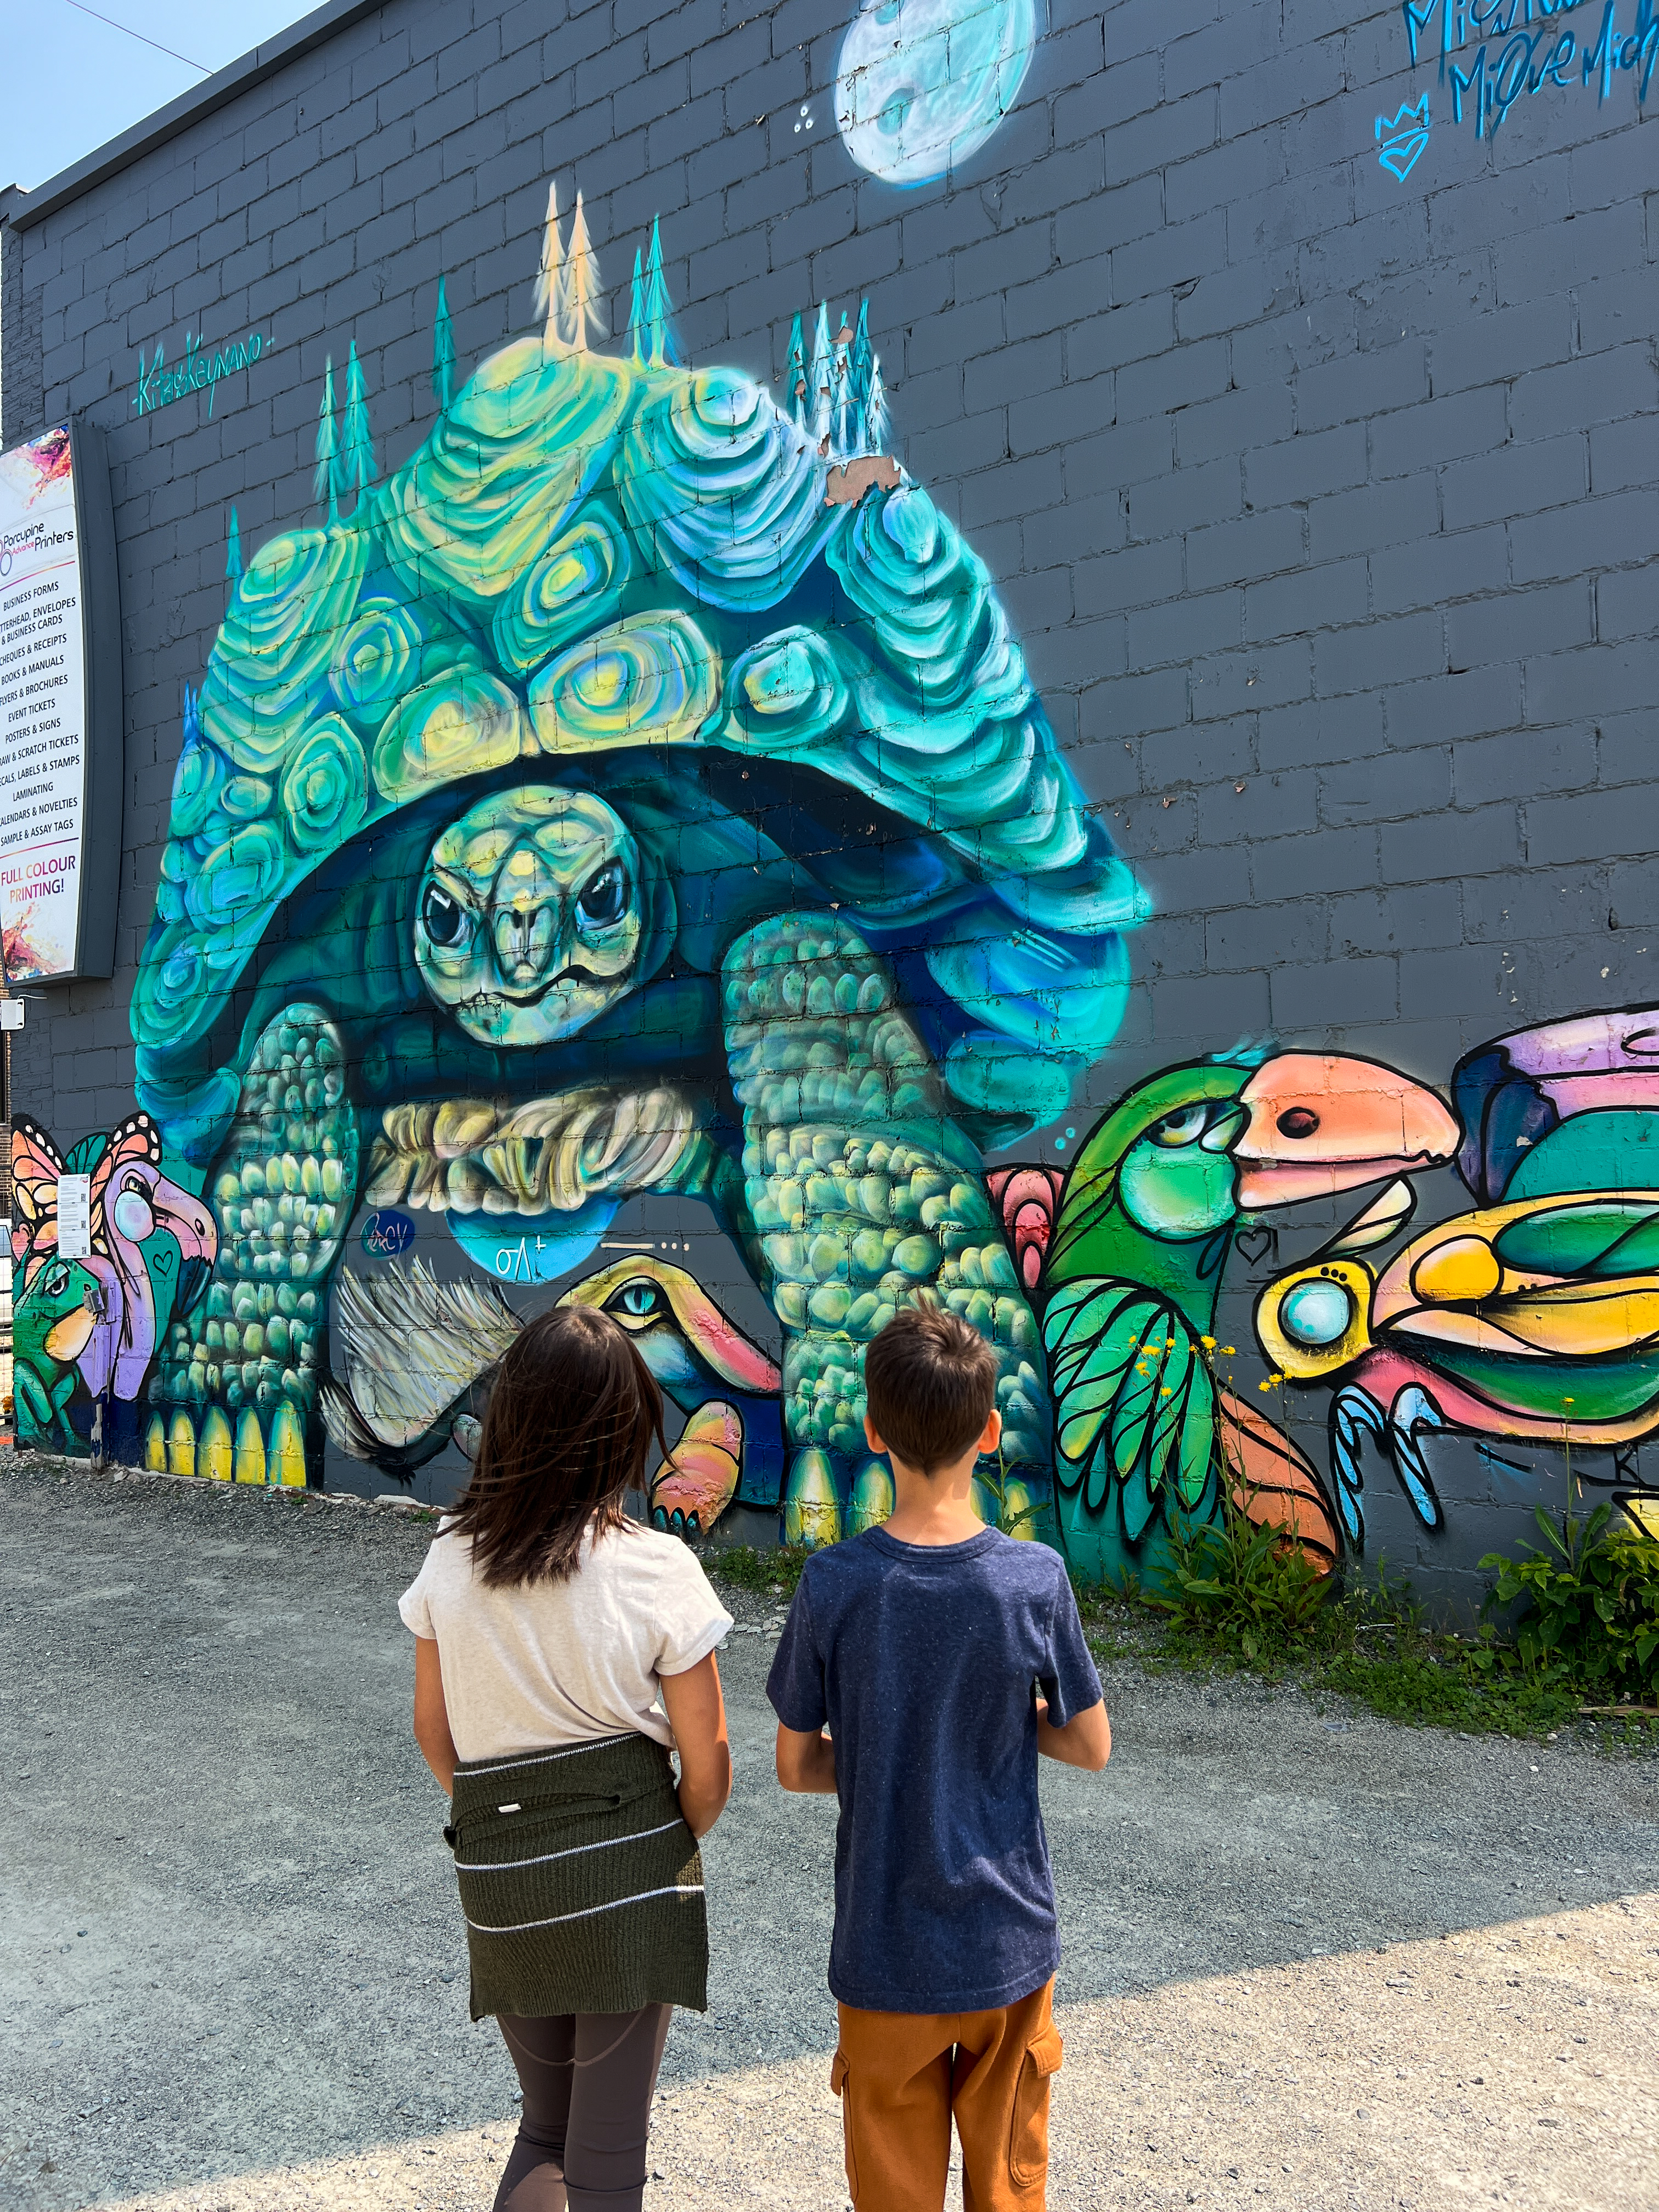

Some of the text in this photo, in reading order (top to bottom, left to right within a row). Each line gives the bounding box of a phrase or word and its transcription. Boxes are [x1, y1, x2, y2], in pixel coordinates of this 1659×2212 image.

[4, 523, 44, 549] Porcupine
[12, 531, 74, 556] Advance Printers
[3, 582, 59, 611] BUSINESS FORMS
[0, 597, 76, 631] TTERHEAD, ENVELOPES
[2, 614, 63, 645] & BUSINESS CARDS
[0, 633, 67, 665] CHEQUES & RECEIPTS
[1, 654, 64, 685] BOOKS & MANUALS
[0, 674, 68, 706] FLYERS & BROCHURES
[8, 698, 55, 723] EVENT TICKETS
[5, 718, 61, 744] POSTERS & SIGNS
[0, 734, 79, 766] RAW & SCRATCH TICKETS
[18, 766, 40, 780] LABELS
[42, 763, 48, 772] &
[49, 755, 80, 771] STAMPS
[13, 782, 54, 802] LAMINATING
[32, 806, 37, 816] &
[39, 797, 78, 815] NOVELTIES
[1, 819, 74, 847] SAMPLE & ASSAY TAGS
[1, 855, 76, 887] FULL COLOUR
[10, 878, 64, 904] PRINTING!
